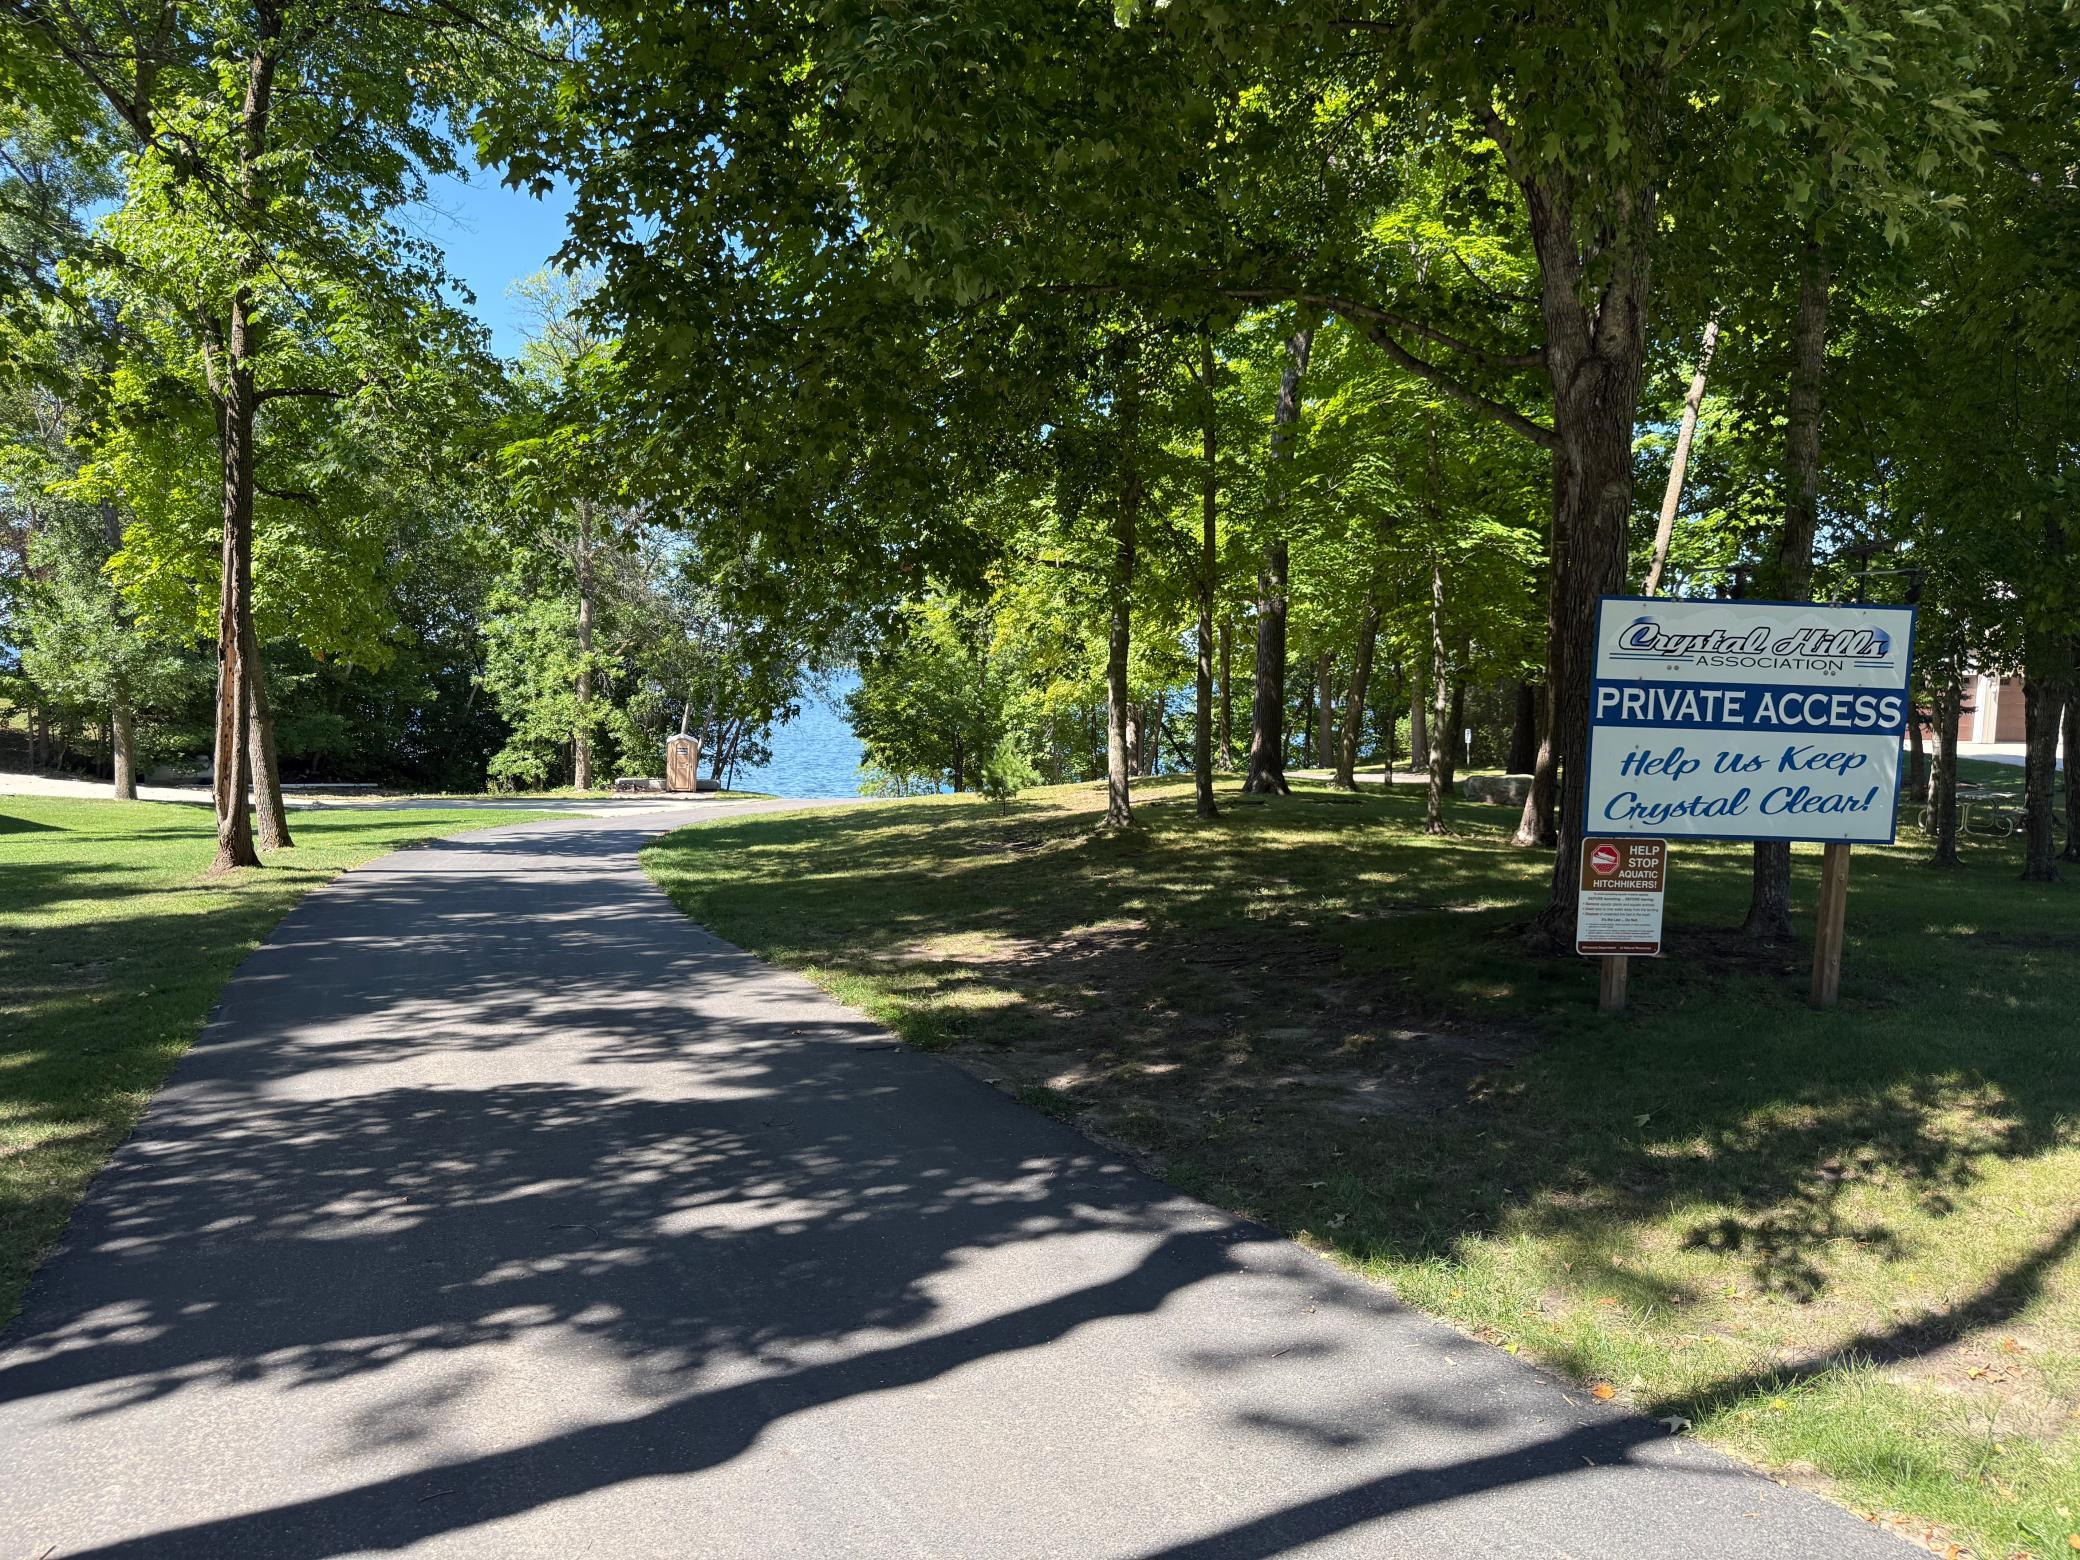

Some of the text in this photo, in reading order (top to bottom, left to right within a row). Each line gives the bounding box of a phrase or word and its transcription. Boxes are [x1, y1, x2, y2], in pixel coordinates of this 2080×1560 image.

[1619, 622, 1889, 658] Crystal Hills
[1696, 655, 1844, 671] ASSOCIATION
[1596, 687, 1902, 728] PRIVATE ACCESS
[1620, 746, 1700, 781] Help
[1777, 745, 1867, 776] Keep
[1604, 786, 1879, 825] Crystal Clear!
[1629, 845, 1660, 856] HELP
[1628, 857, 1659, 868] STOP
[1618, 870, 1659, 879] AQUATIC
[1593, 879, 1657, 889] HITCHHIKERS!
